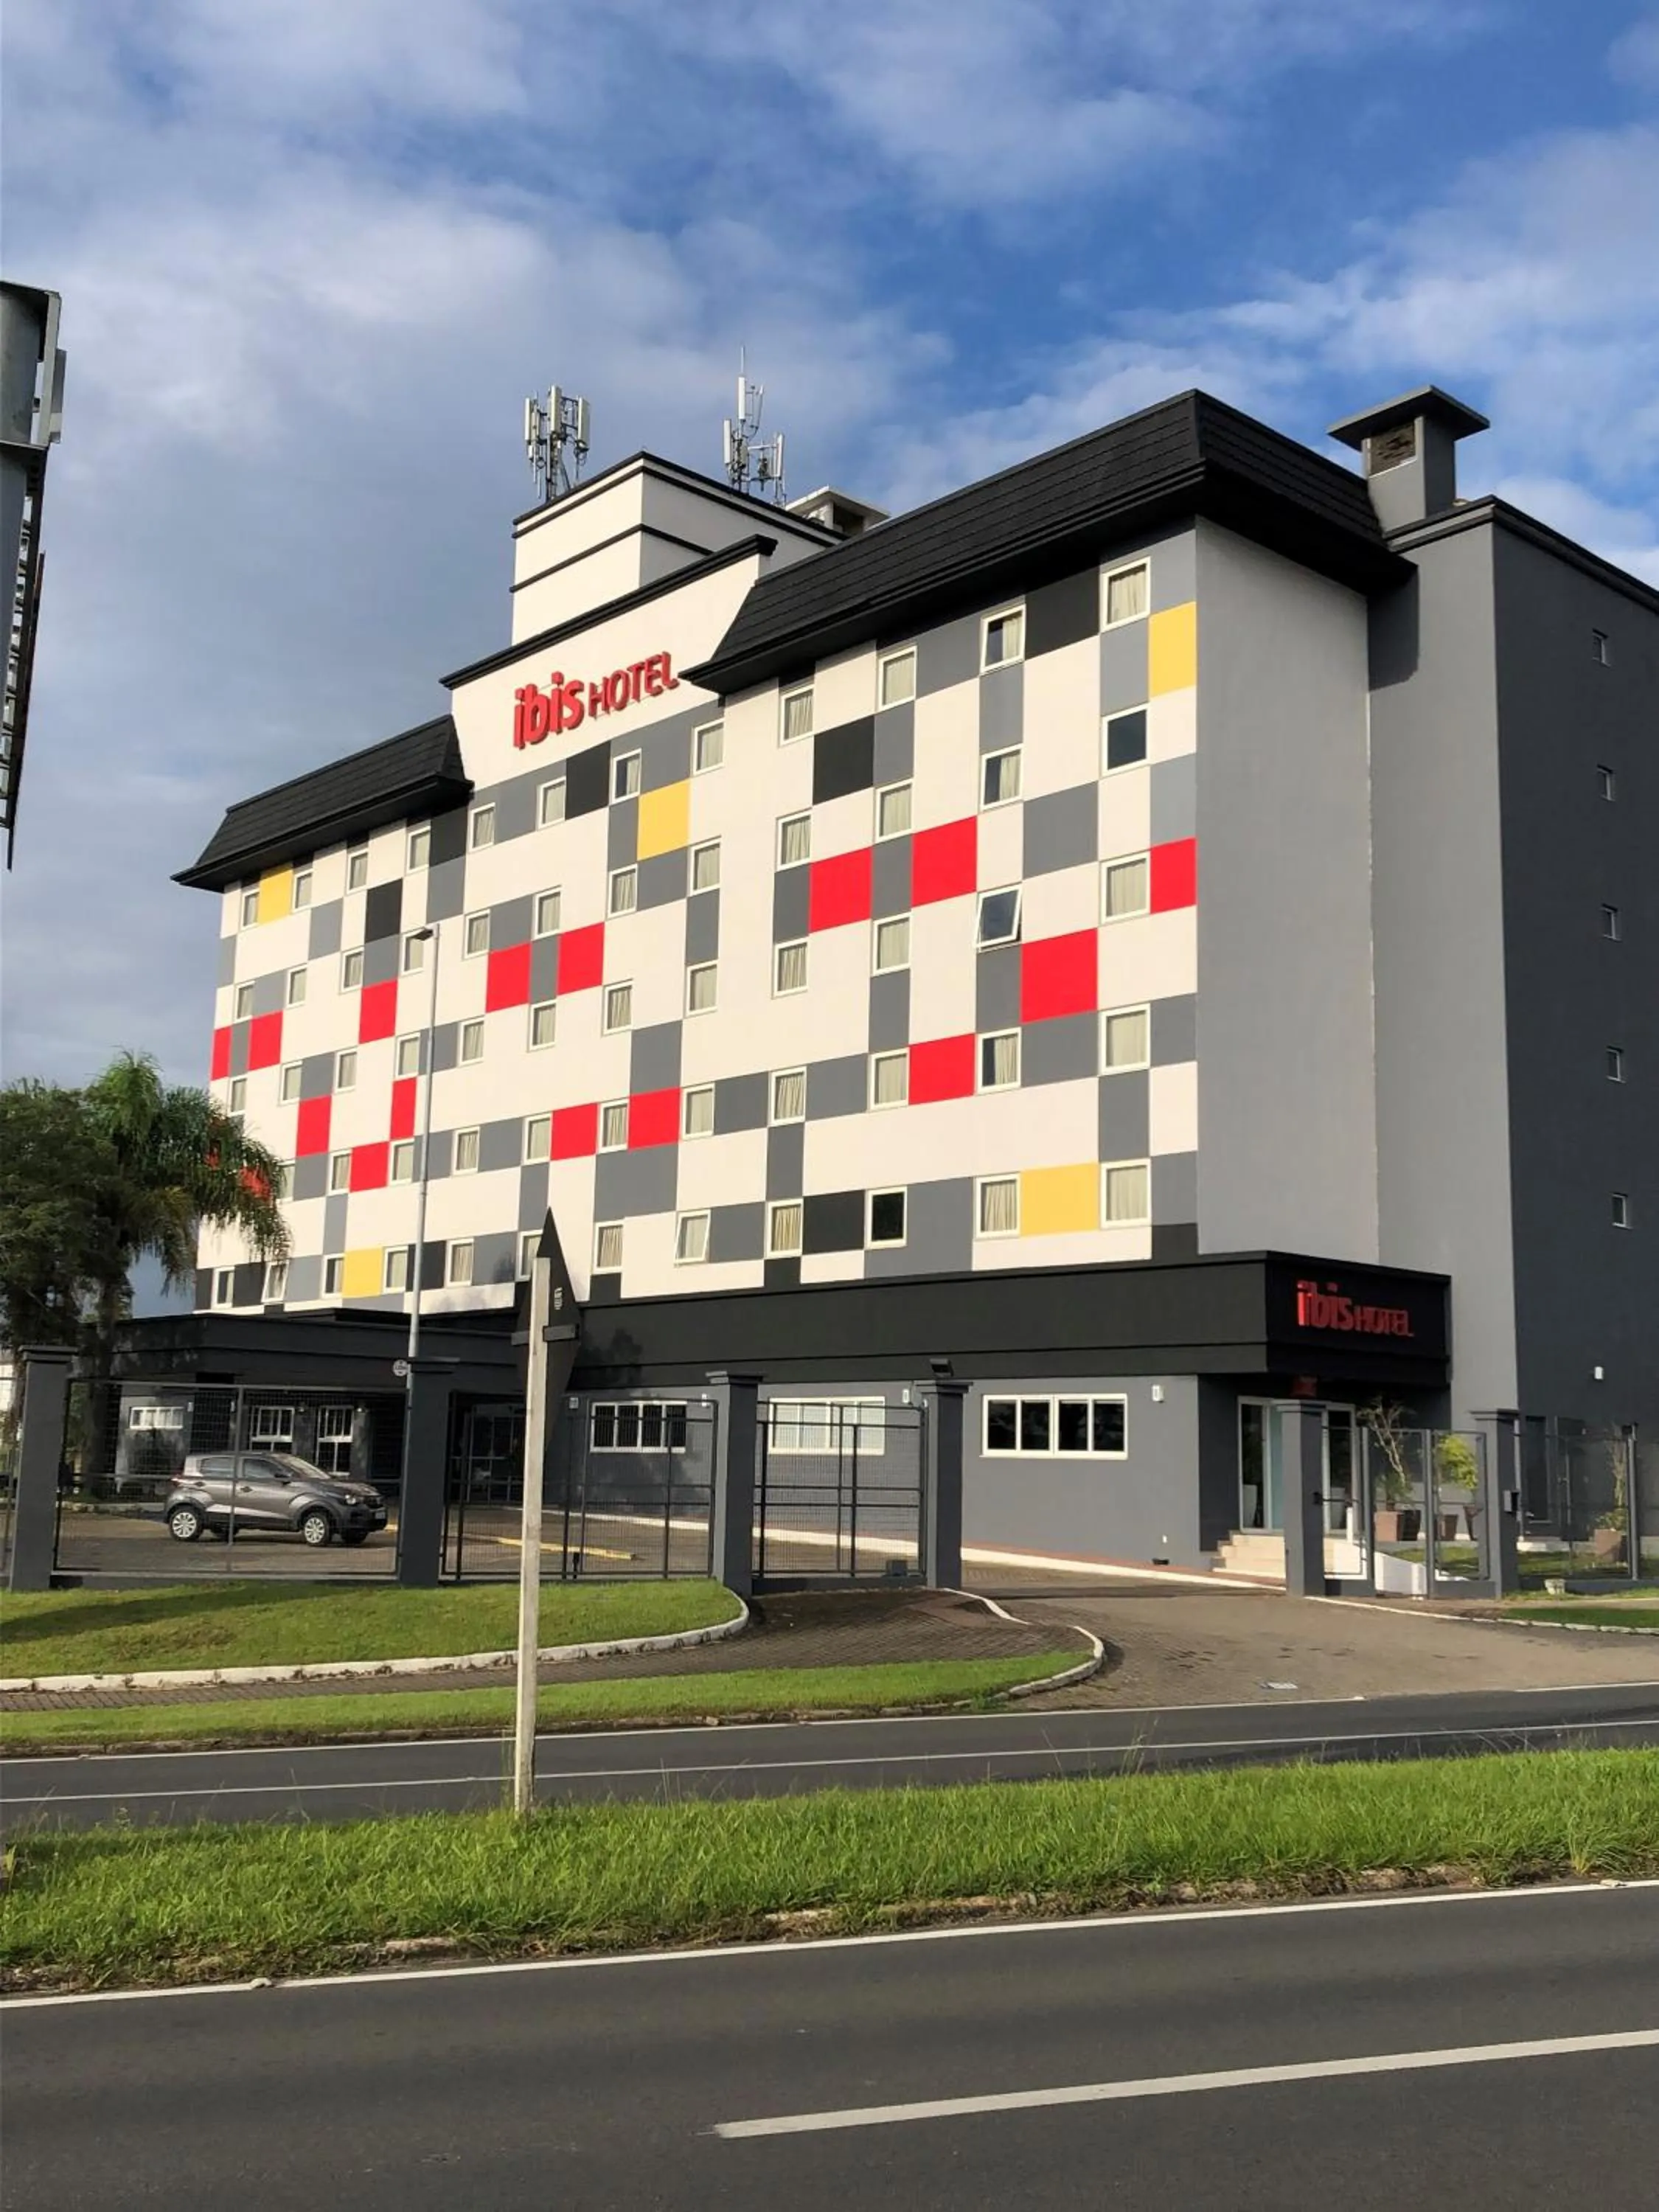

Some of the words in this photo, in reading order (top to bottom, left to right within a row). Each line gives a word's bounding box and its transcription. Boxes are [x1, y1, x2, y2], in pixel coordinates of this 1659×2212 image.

[514, 671, 584, 749] ibis
[588, 651, 680, 718] HOTEL
[1297, 1280, 1354, 1330] ibis
[1355, 1305, 1414, 1337] HOTEL
